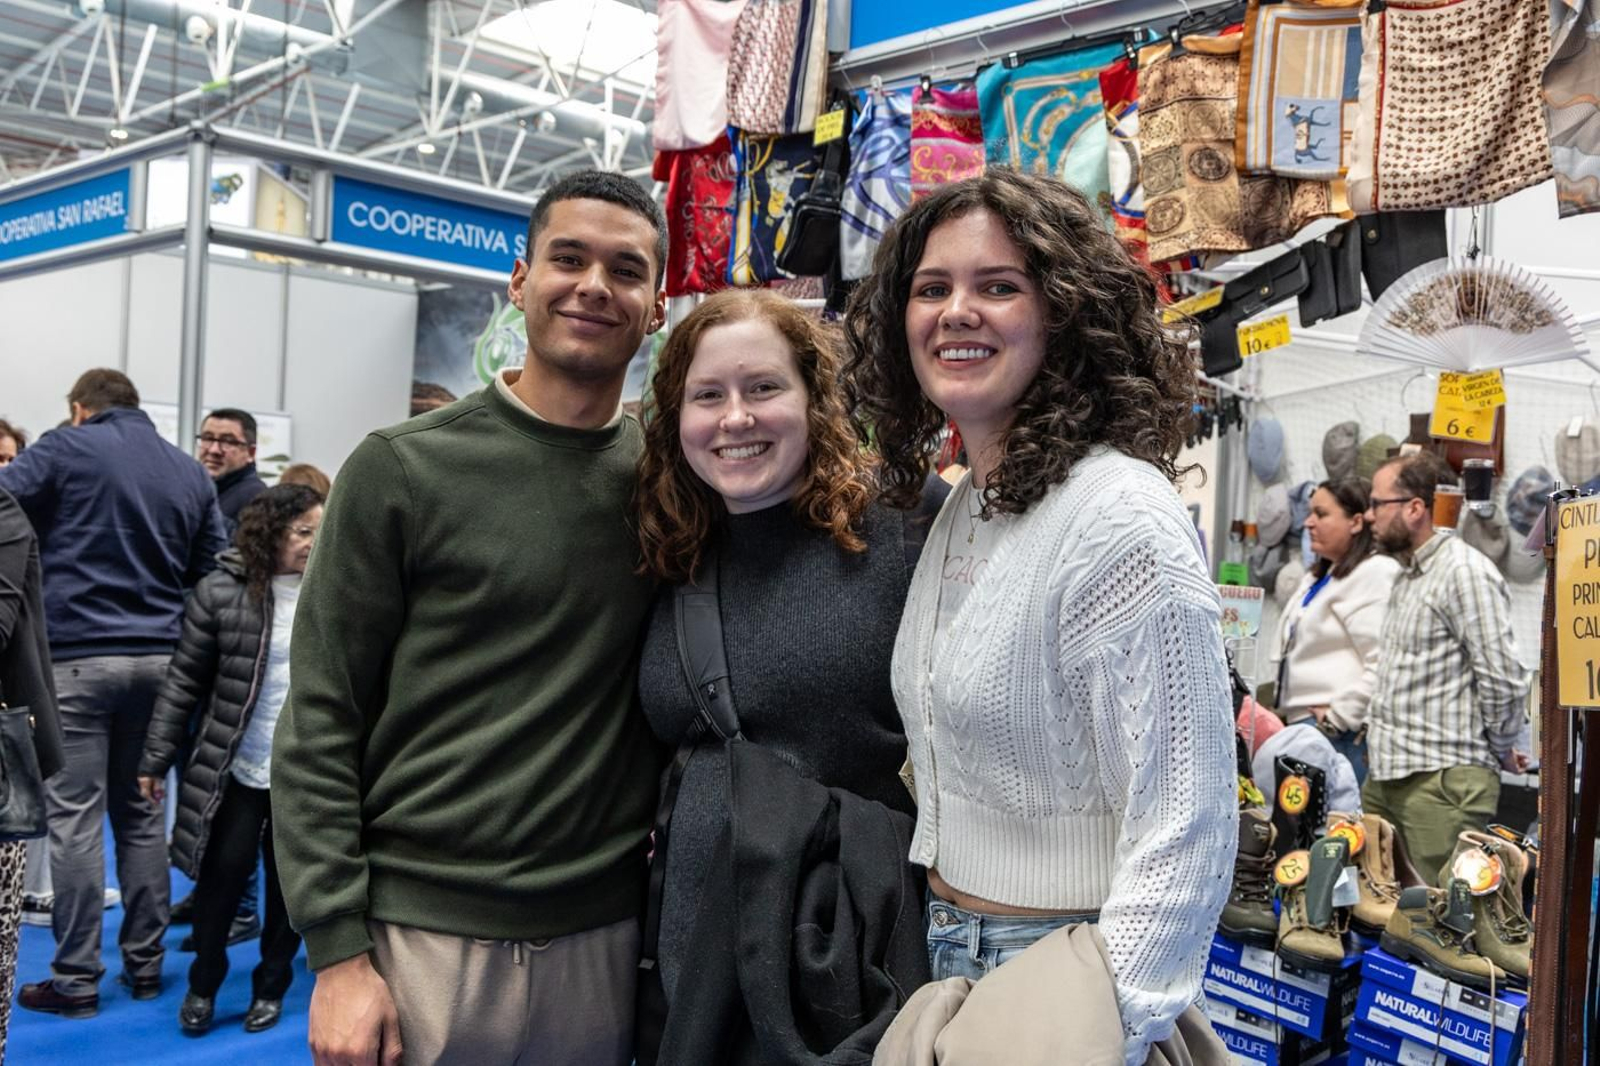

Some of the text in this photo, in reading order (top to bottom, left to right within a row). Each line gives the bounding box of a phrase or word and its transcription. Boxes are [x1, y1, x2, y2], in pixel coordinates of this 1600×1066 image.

[0, 209, 56, 244] OPERATIVA
[57, 202, 82, 230] SAN
[82, 191, 125, 224] RAFAEL
[347, 201, 509, 255] COOPERATIVA
[1245, 338, 1262, 355] 10
[1462, 379, 1490, 392] VIRGEN
[1475, 386, 1503, 398] CABEZA
[1447, 418, 1476, 437] 6 €
[1585, 538, 1600, 569] P
[1586, 660, 1600, 700] 1
[1286, 787, 1302, 805] 45
[1282, 858, 1303, 879] 25
